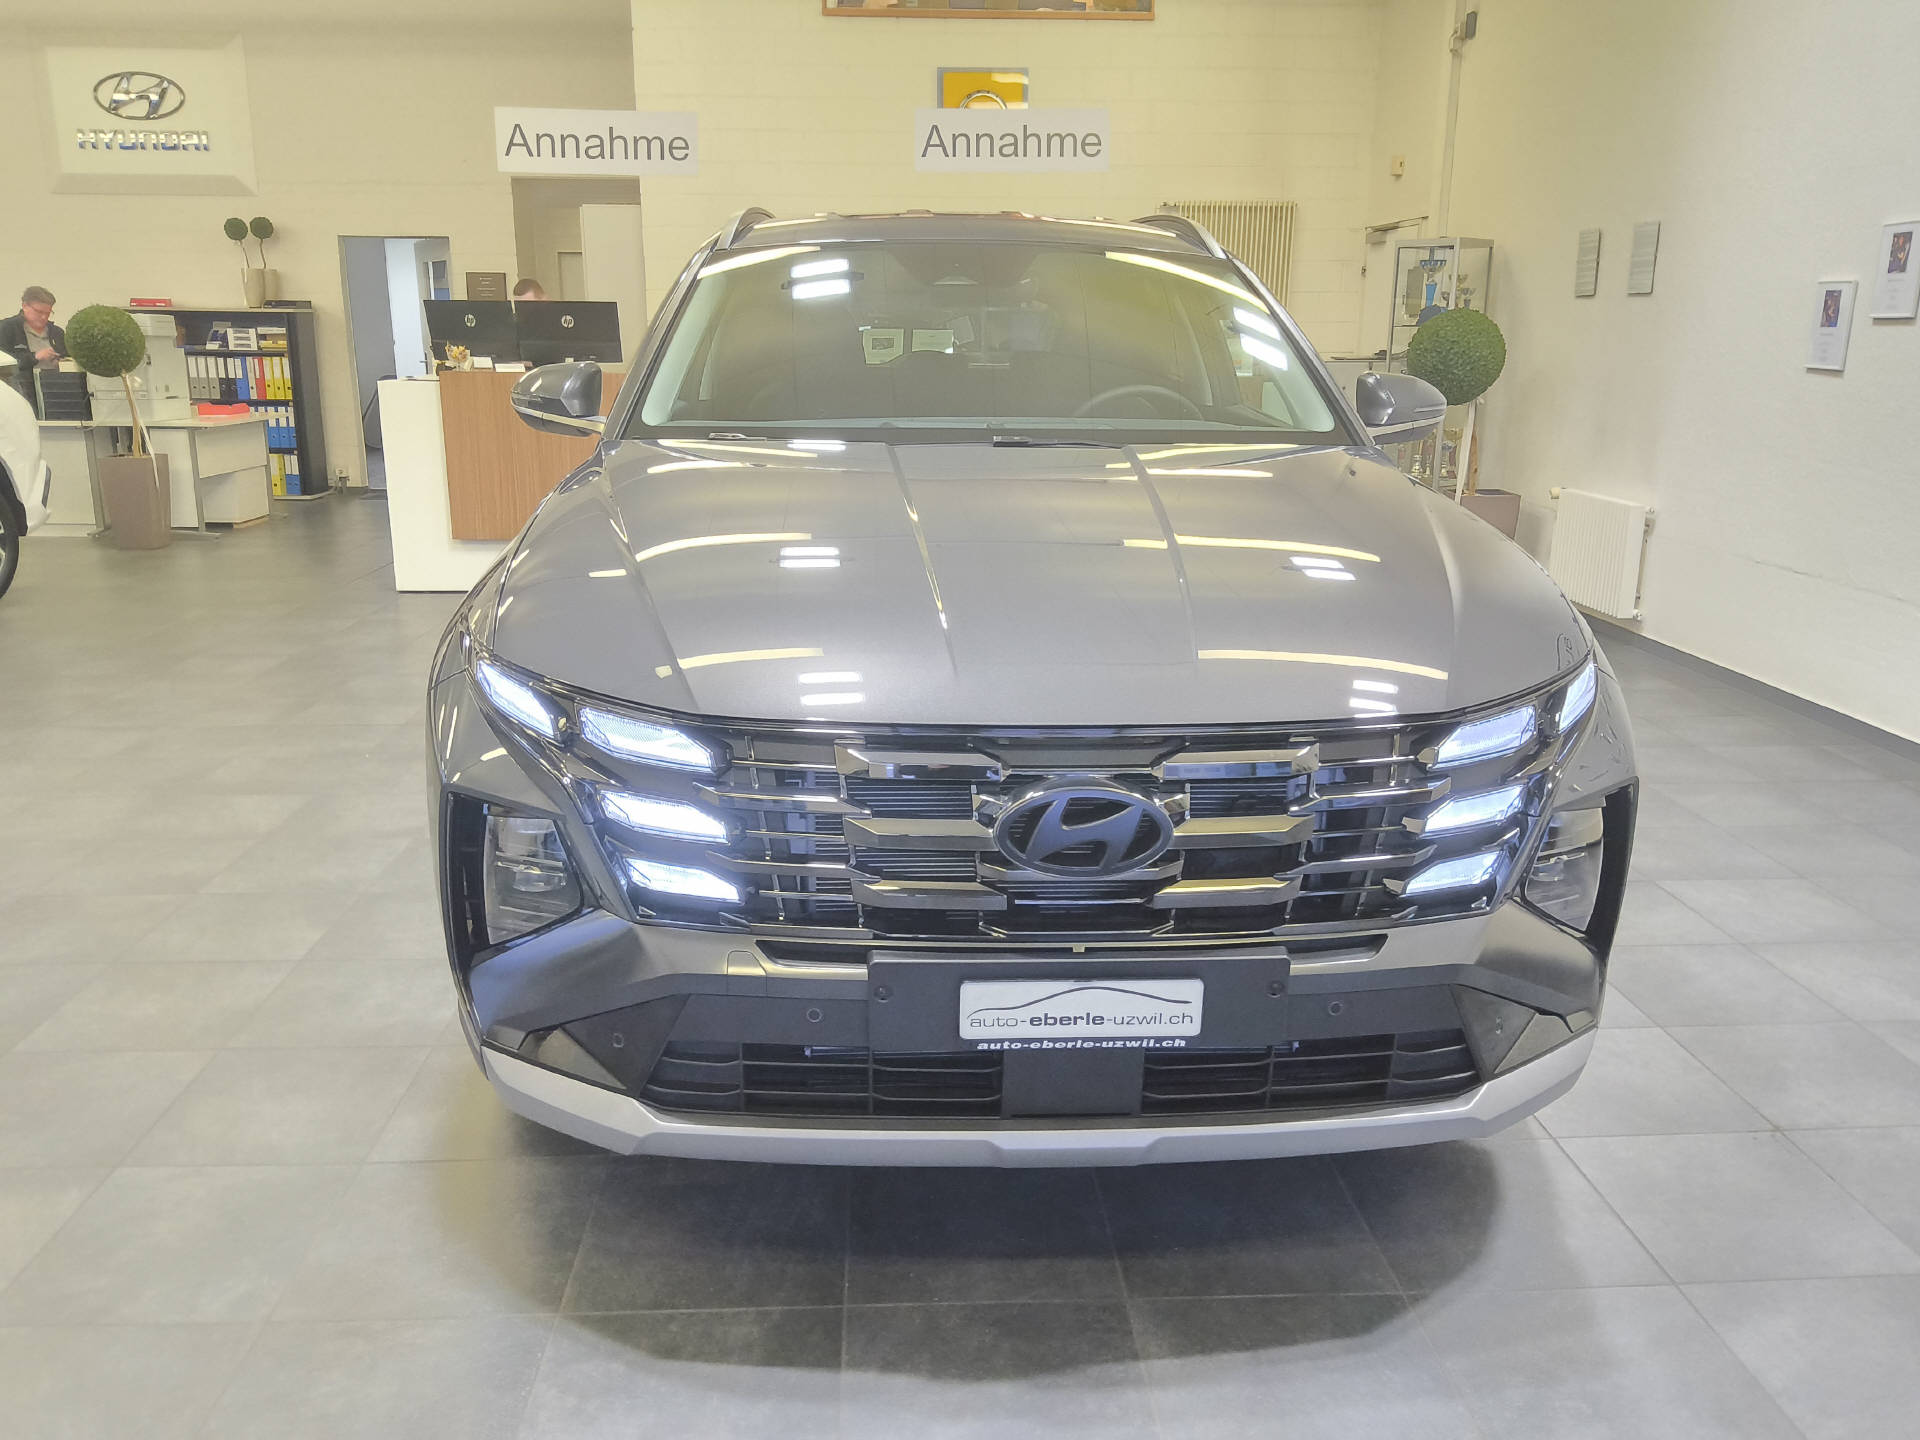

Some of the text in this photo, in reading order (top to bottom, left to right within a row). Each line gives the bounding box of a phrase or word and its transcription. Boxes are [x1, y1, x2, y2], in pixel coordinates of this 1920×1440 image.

[76, 128, 209, 151] HYUNDAI
[505, 123, 690, 161] Annahme
[921, 124, 1102, 158] Annahme
[465, 313, 476, 328] hp
[562, 314, 574, 328] hp
[969, 1012, 1194, 1028] auto-eberle-uzwil.ch
[976, 1038, 1187, 1050] auto-eberle-uzwil.ch
